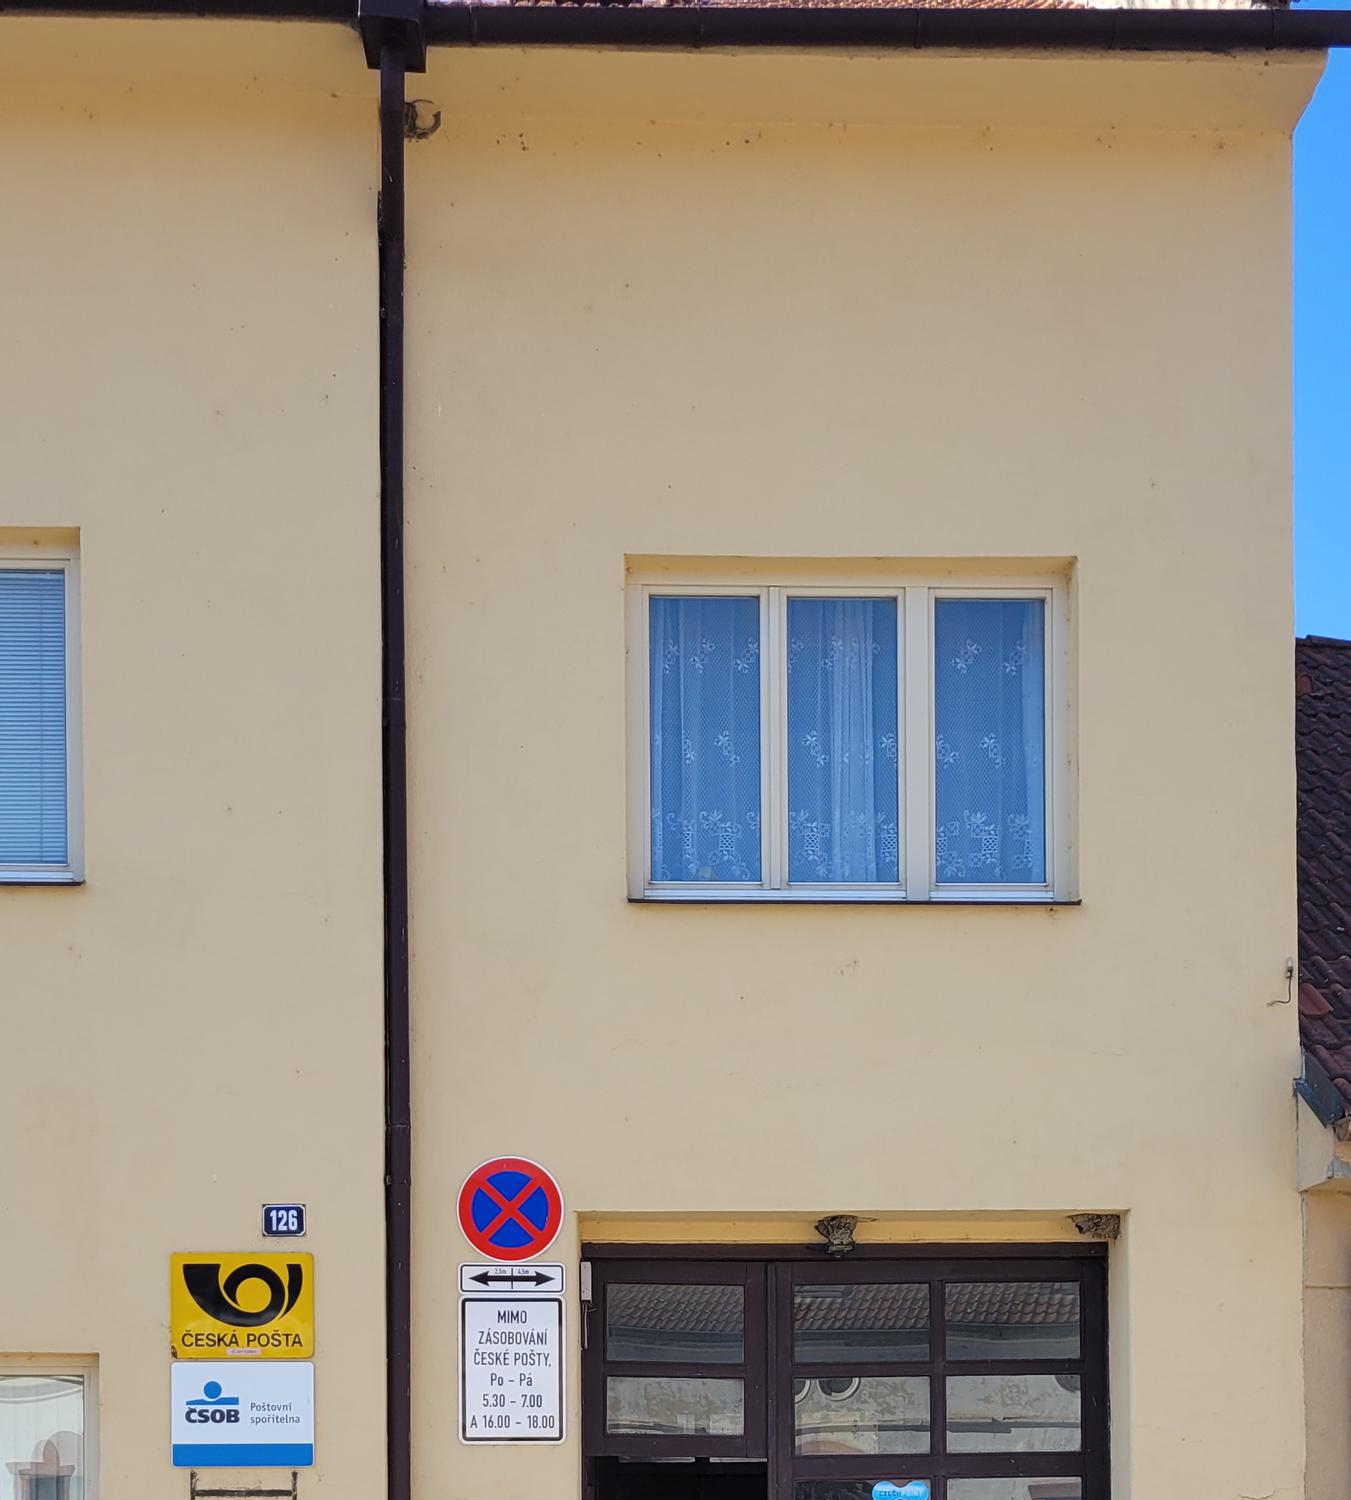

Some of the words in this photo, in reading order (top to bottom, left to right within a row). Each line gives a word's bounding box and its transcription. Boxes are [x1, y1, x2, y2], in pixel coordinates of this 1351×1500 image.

[269, 1209, 299, 1232] 126
[497, 1310, 528, 1324] MIMO
[181, 1329, 240, 1348] ČESKÁ
[246, 1329, 304, 1348] POŠTA
[478, 1328, 548, 1346] ZÁSOBOVÁNÍ
[473, 1349, 510, 1367] ČESKÉ
[514, 1350, 552, 1368] POŠTY,
[490, 1373, 504, 1387] Po
[519, 1372, 533, 1387] Pá
[250, 1402, 293, 1412] Poštovní
[482, 1394, 506, 1408] 5.30
[521, 1394, 543, 1408] 7.00
[184, 1407, 240, 1424] ČSOB
[250, 1414, 301, 1426] spořitelna
[470, 1415, 478, 1429] A
[482, 1415, 511, 1429] 16.00
[527, 1415, 555, 1429] 18.00
